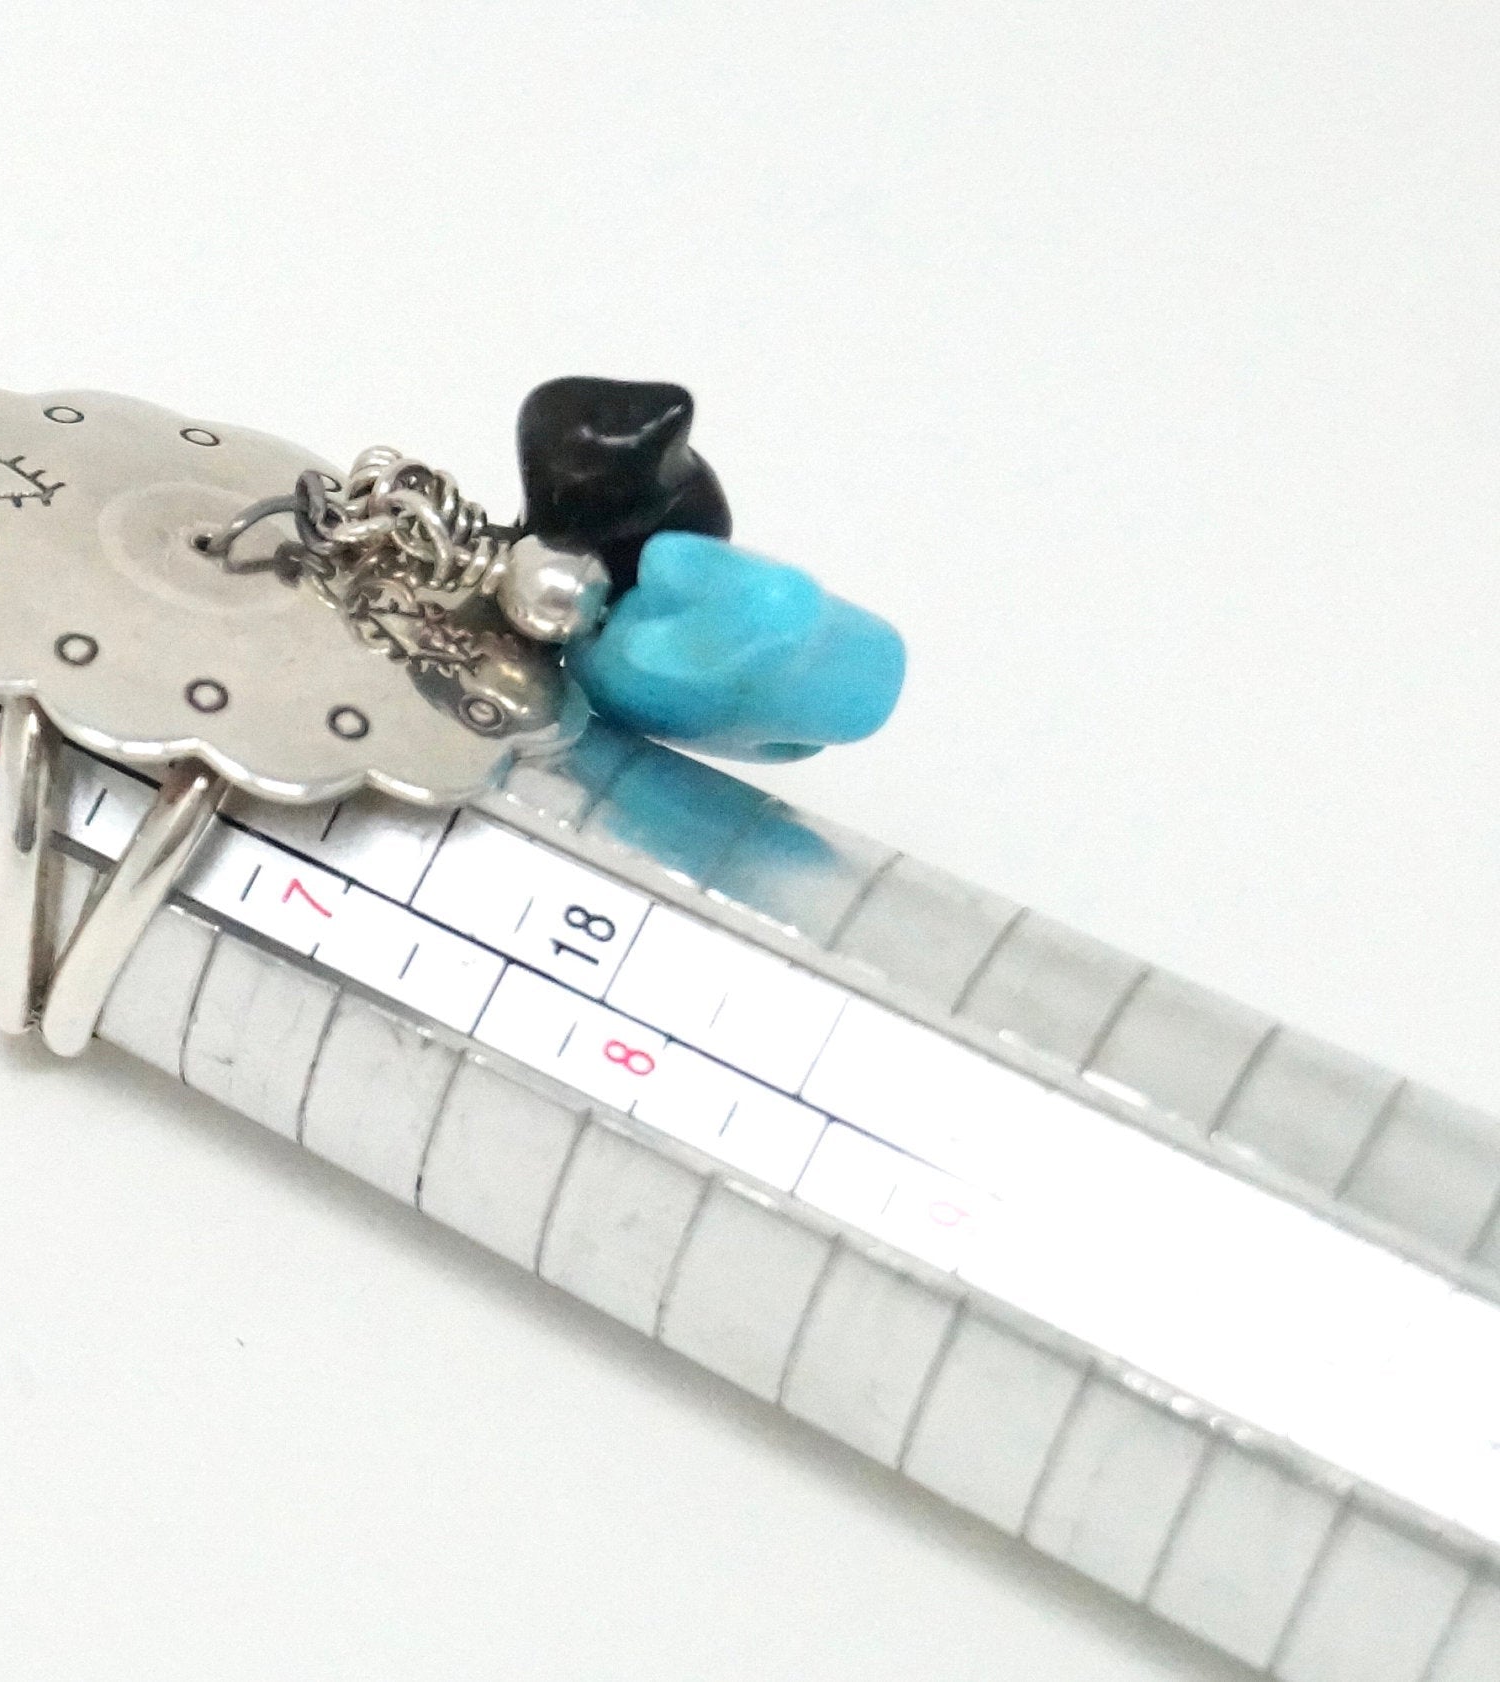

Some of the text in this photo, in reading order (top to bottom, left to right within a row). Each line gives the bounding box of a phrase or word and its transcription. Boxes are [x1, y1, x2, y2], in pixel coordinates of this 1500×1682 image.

[281, 878, 332, 918] 7
[551, 904, 617, 966] 18
[602, 1039, 657, 1076] 8
